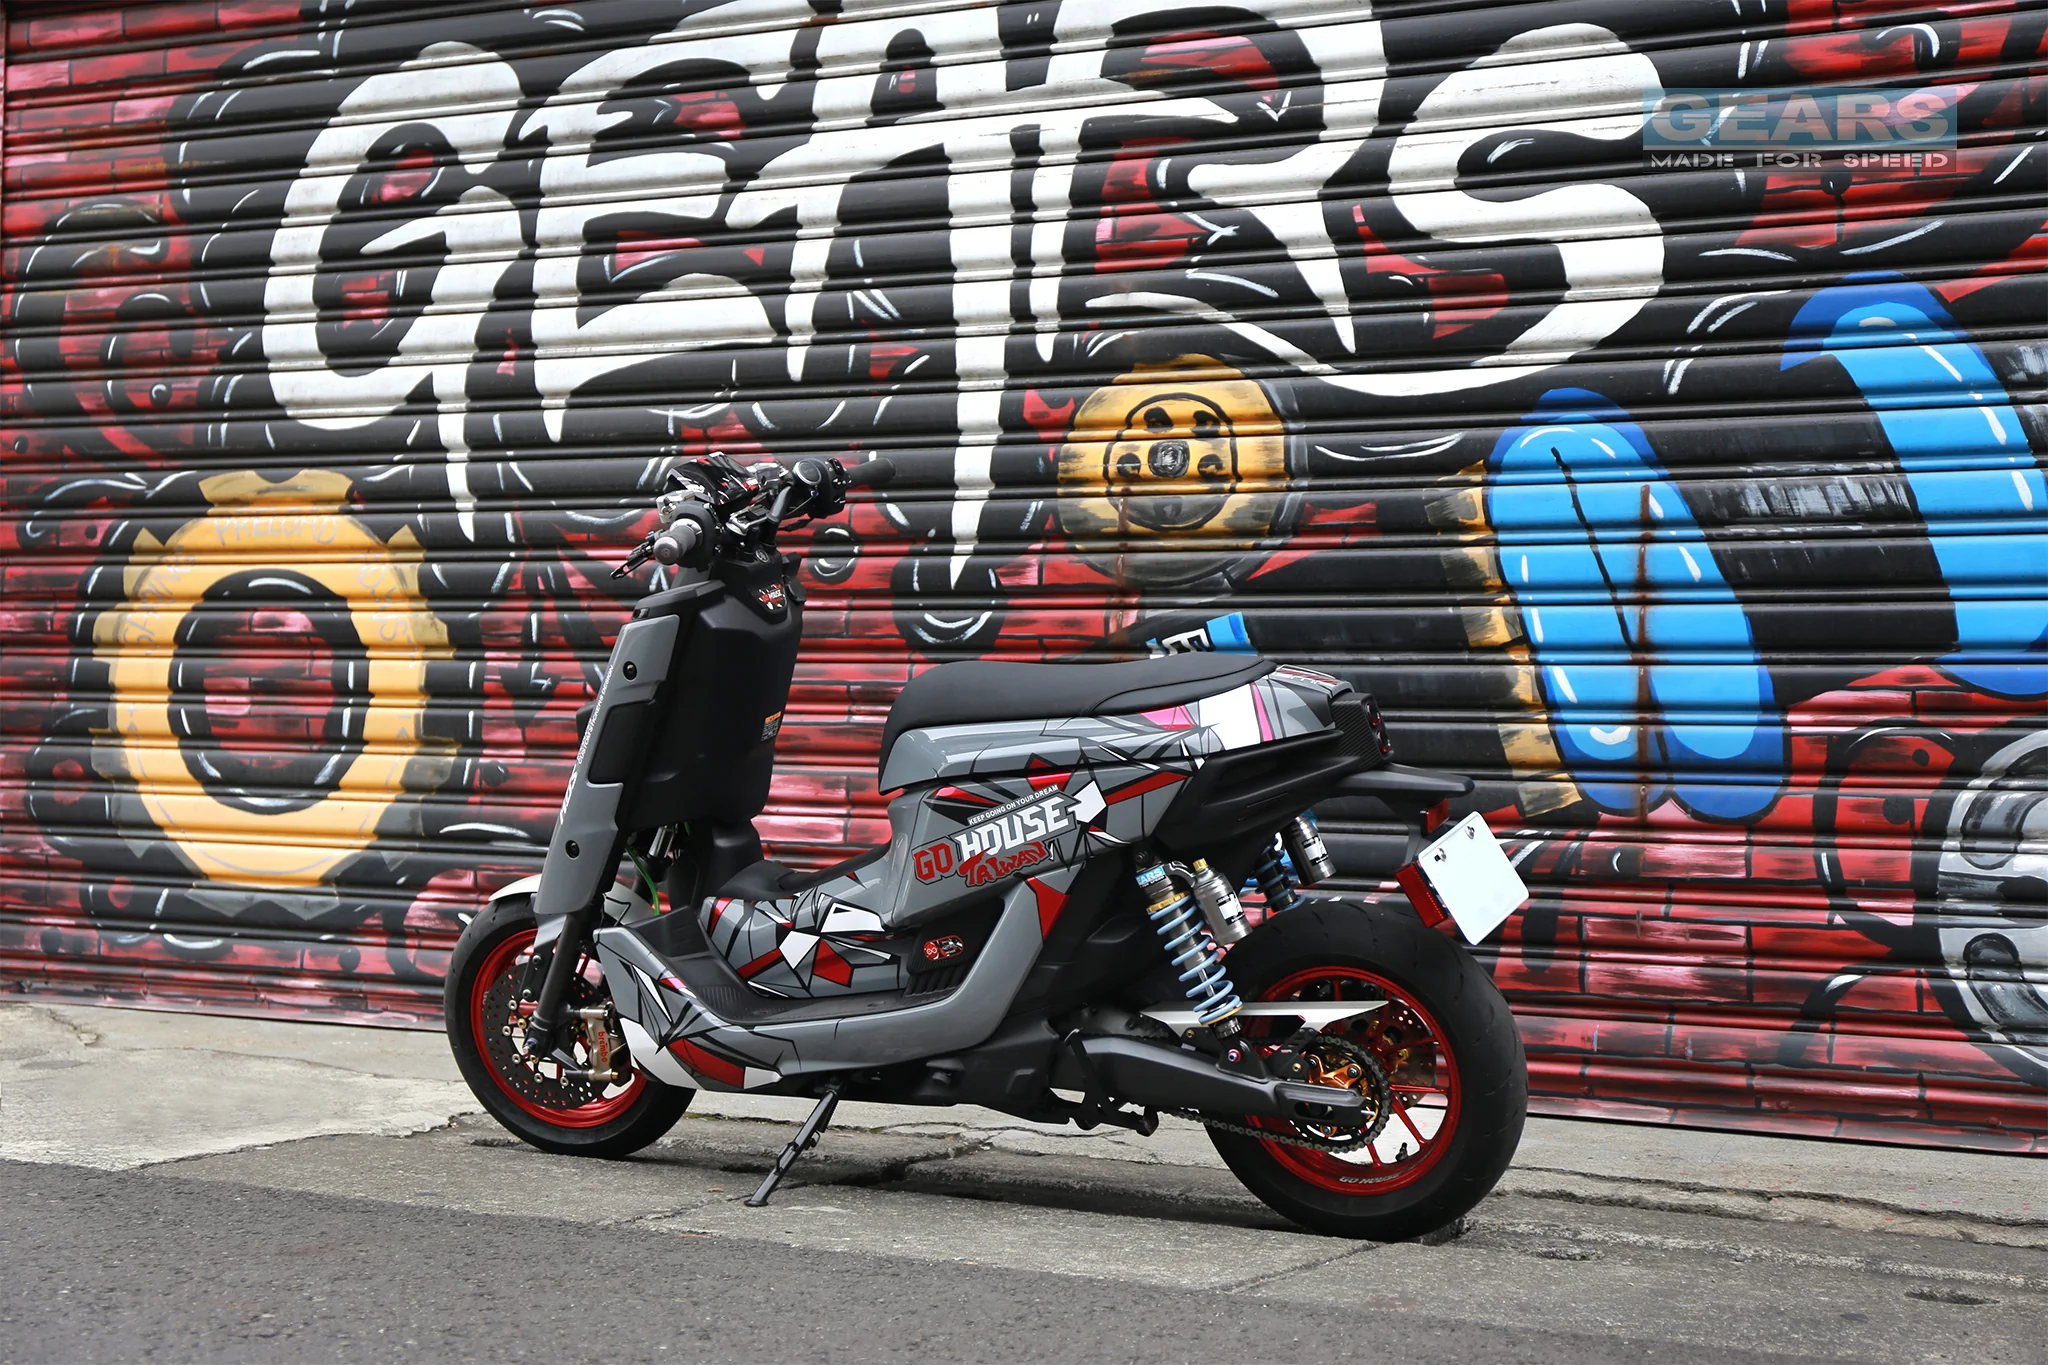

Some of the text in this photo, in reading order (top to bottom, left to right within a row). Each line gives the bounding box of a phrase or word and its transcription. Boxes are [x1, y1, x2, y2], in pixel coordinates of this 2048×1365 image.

[263, 0, 1664, 588] GEARS
[212, 506, 339, 546] PRELOAD
[601, 664, 613, 694] DESIGN
[968, 784, 1059, 826] KEEP GOING ON YOUR DREAM
[912, 796, 1070, 882] GO HOUSE
[957, 841, 1049, 886] TAIWAN
[598, 1031, 609, 1063] brembo
